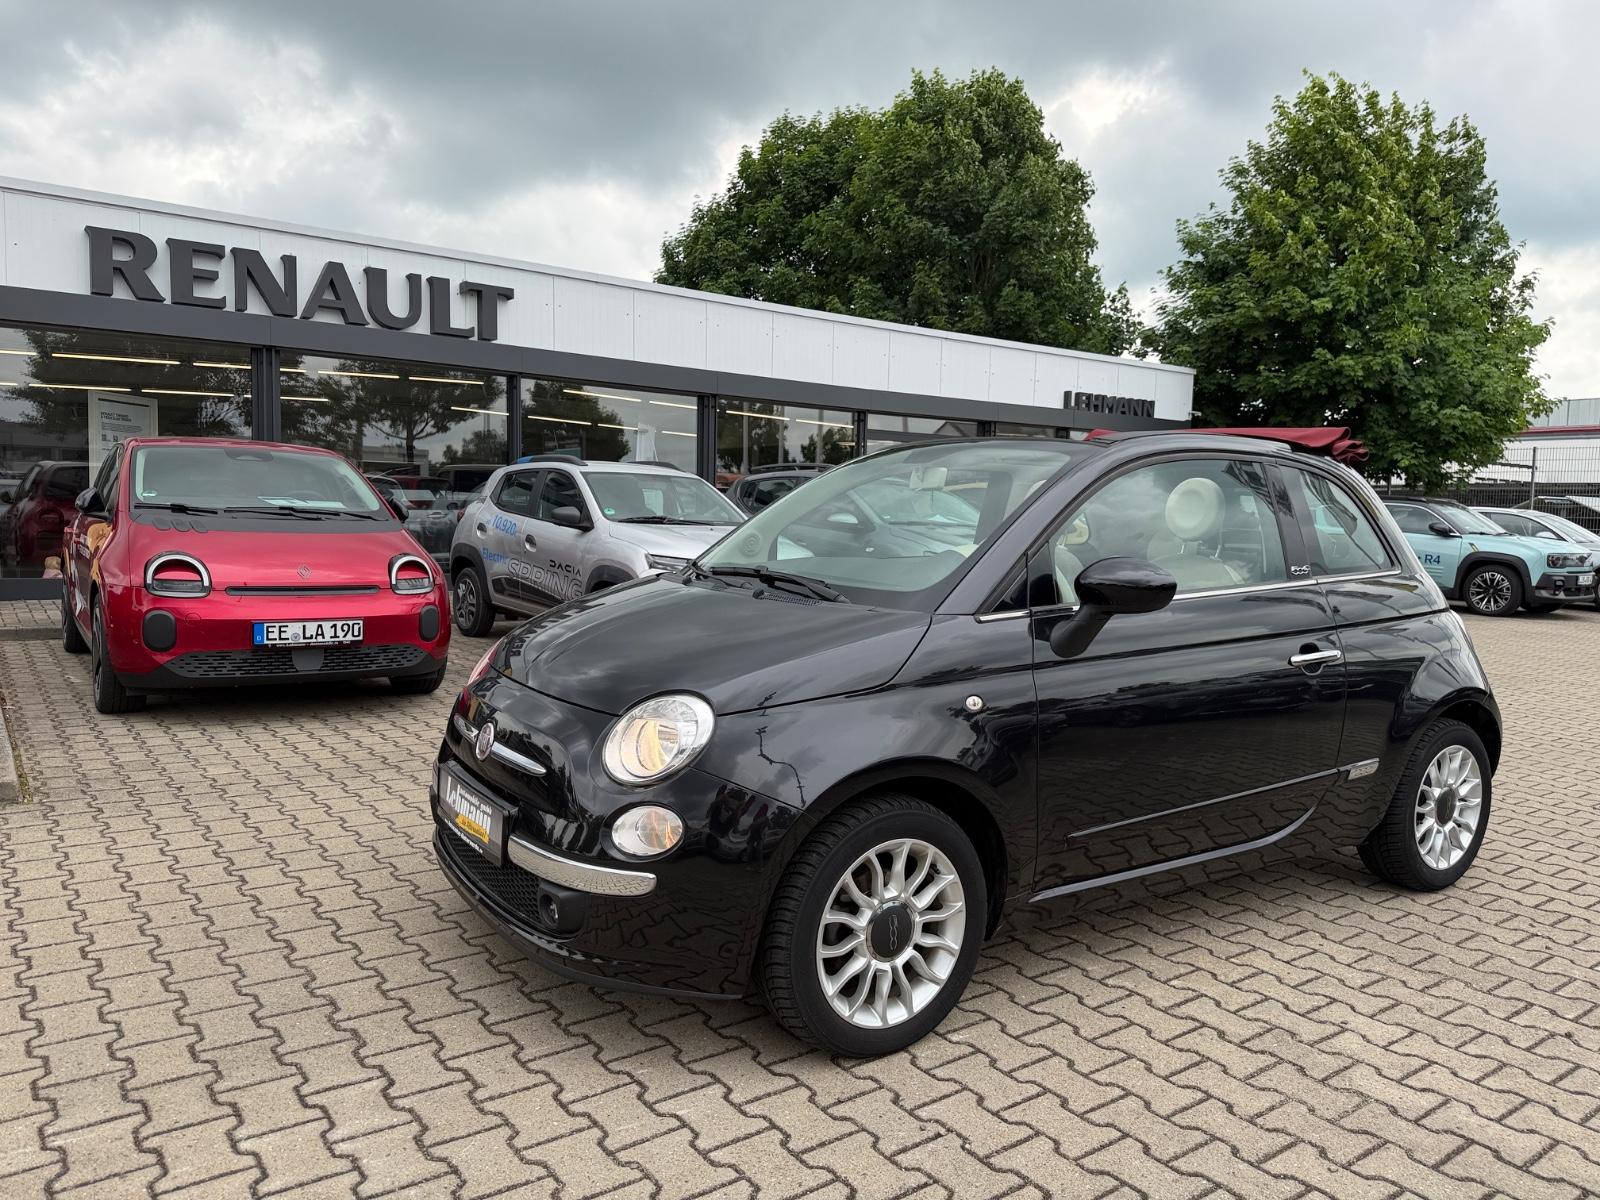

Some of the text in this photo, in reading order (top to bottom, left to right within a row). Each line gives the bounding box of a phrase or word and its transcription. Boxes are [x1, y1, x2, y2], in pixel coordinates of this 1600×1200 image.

[84, 225, 515, 342] RENAULT
[1063, 390, 1156, 418] LEHMANN
[549, 559, 582, 576] DACIA
[1424, 554, 1441, 564] R4
[508, 558, 583, 600] SPRING
[265, 622, 361, 641] EE LA 190
